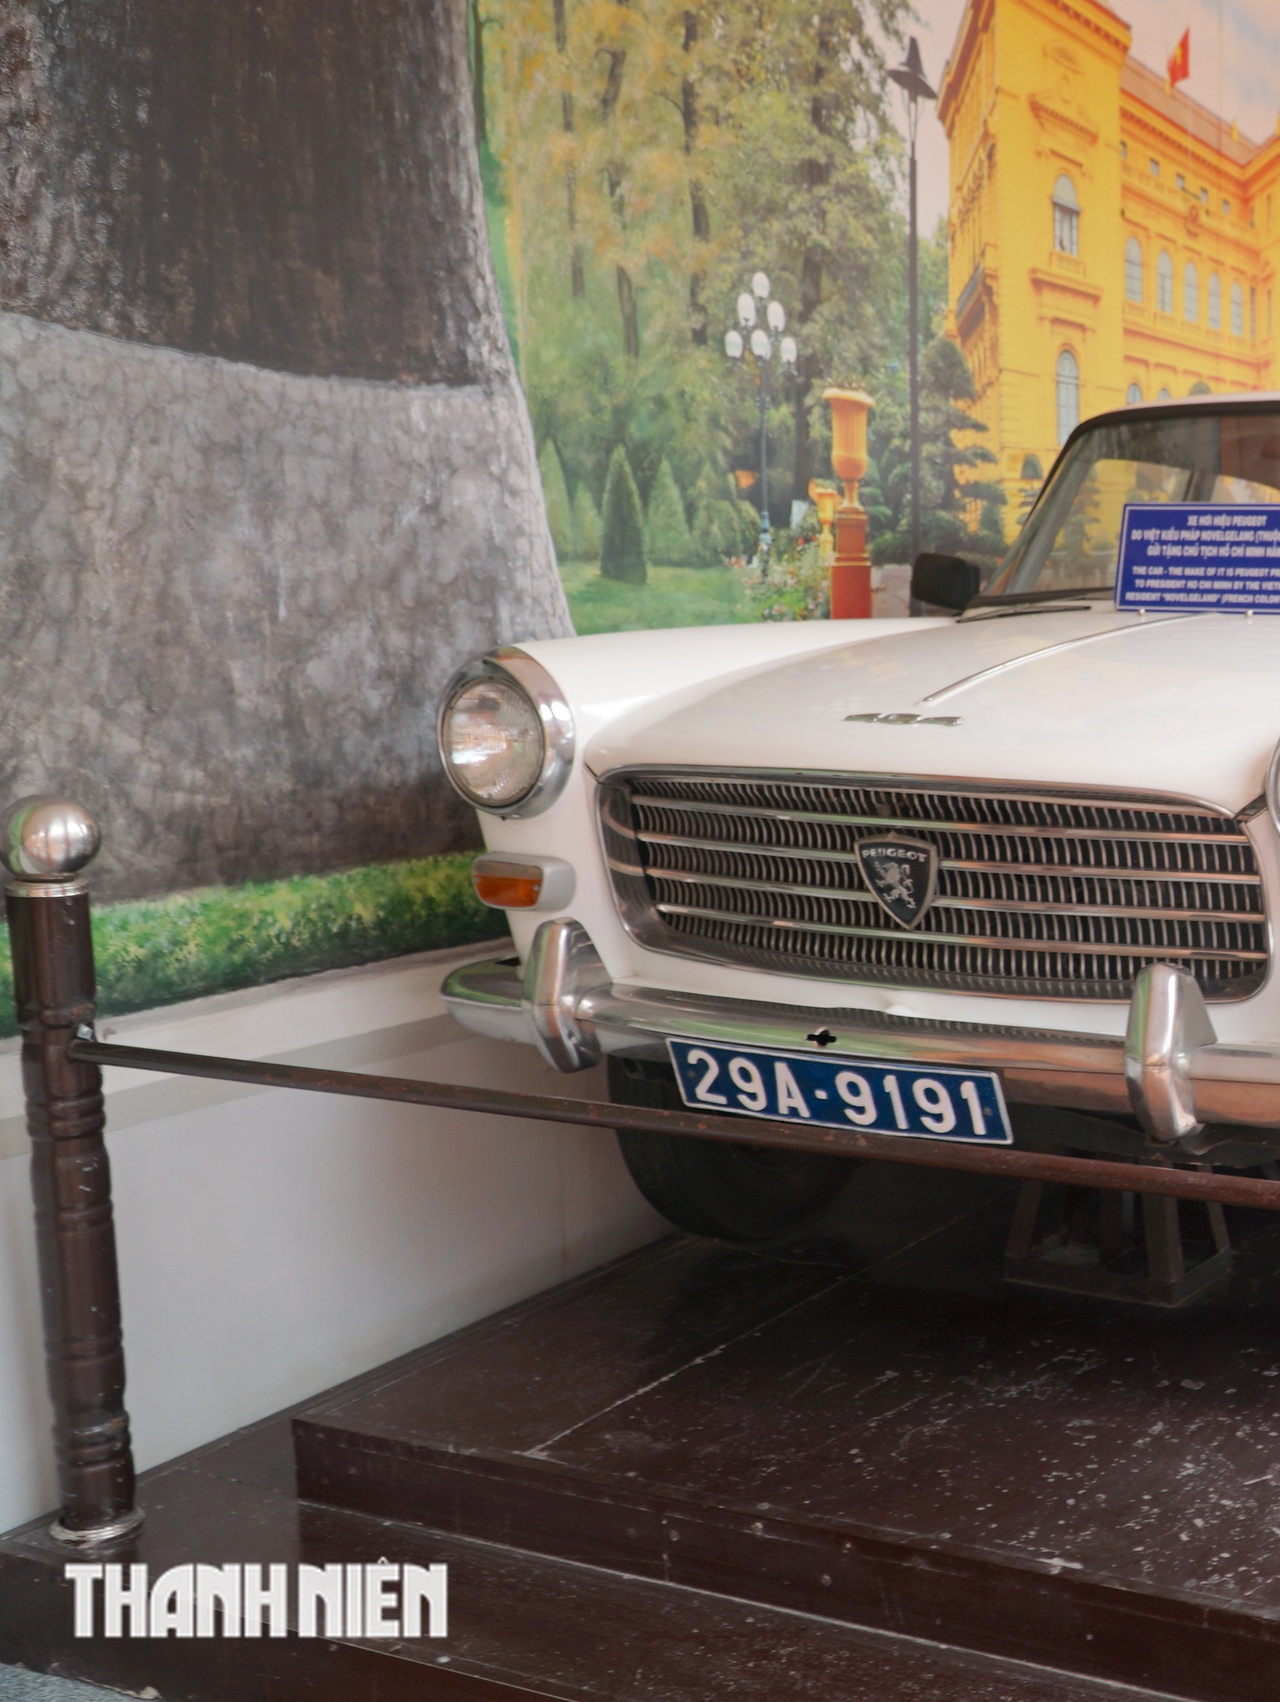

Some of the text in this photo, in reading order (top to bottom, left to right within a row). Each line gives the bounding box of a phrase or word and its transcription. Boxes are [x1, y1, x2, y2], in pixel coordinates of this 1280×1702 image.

[1186, 515, 1198, 526] XE
[1232, 515, 1268, 527] PEUGEOT
[1131, 529, 1143, 540] DO
[1143, 528, 1161, 543] VIỆT
[1180, 527, 1201, 541] PHÁP
[1162, 542, 1183, 559] TẶNG
[1183, 542, 1200, 557] CHỦ
[1200, 545, 1219, 559] TỊCH
[1231, 543, 1245, 557] CHÍ
[1245, 546, 1266, 557] MINH
[1132, 566, 1147, 575] THE
[1148, 566, 1163, 575] CAR
[1168, 566, 1183, 576] THE
[1184, 566, 1205, 576] MAKE
[1206, 567, 1216, 576] OF
[1217, 567, 1225, 576] IT
[1226, 567, 1234, 577] IS
[1234, 568, 1269, 577] PEUGEOT
[1135, 579, 1145, 588] TO
[1145, 579, 1186, 589] PRESIDENT
[1187, 580, 1198, 589] HO
[1199, 580, 1213, 589] CHI
[1213, 580, 1232, 590] MINH
[1233, 580, 1244, 590] BY
[1245, 581, 1261, 590] THE
[1125, 592, 1161, 602] RESIDENT
[1221, 594, 1254, 605] (FRENCH
[862, 848, 928, 862] PEUGEOT
